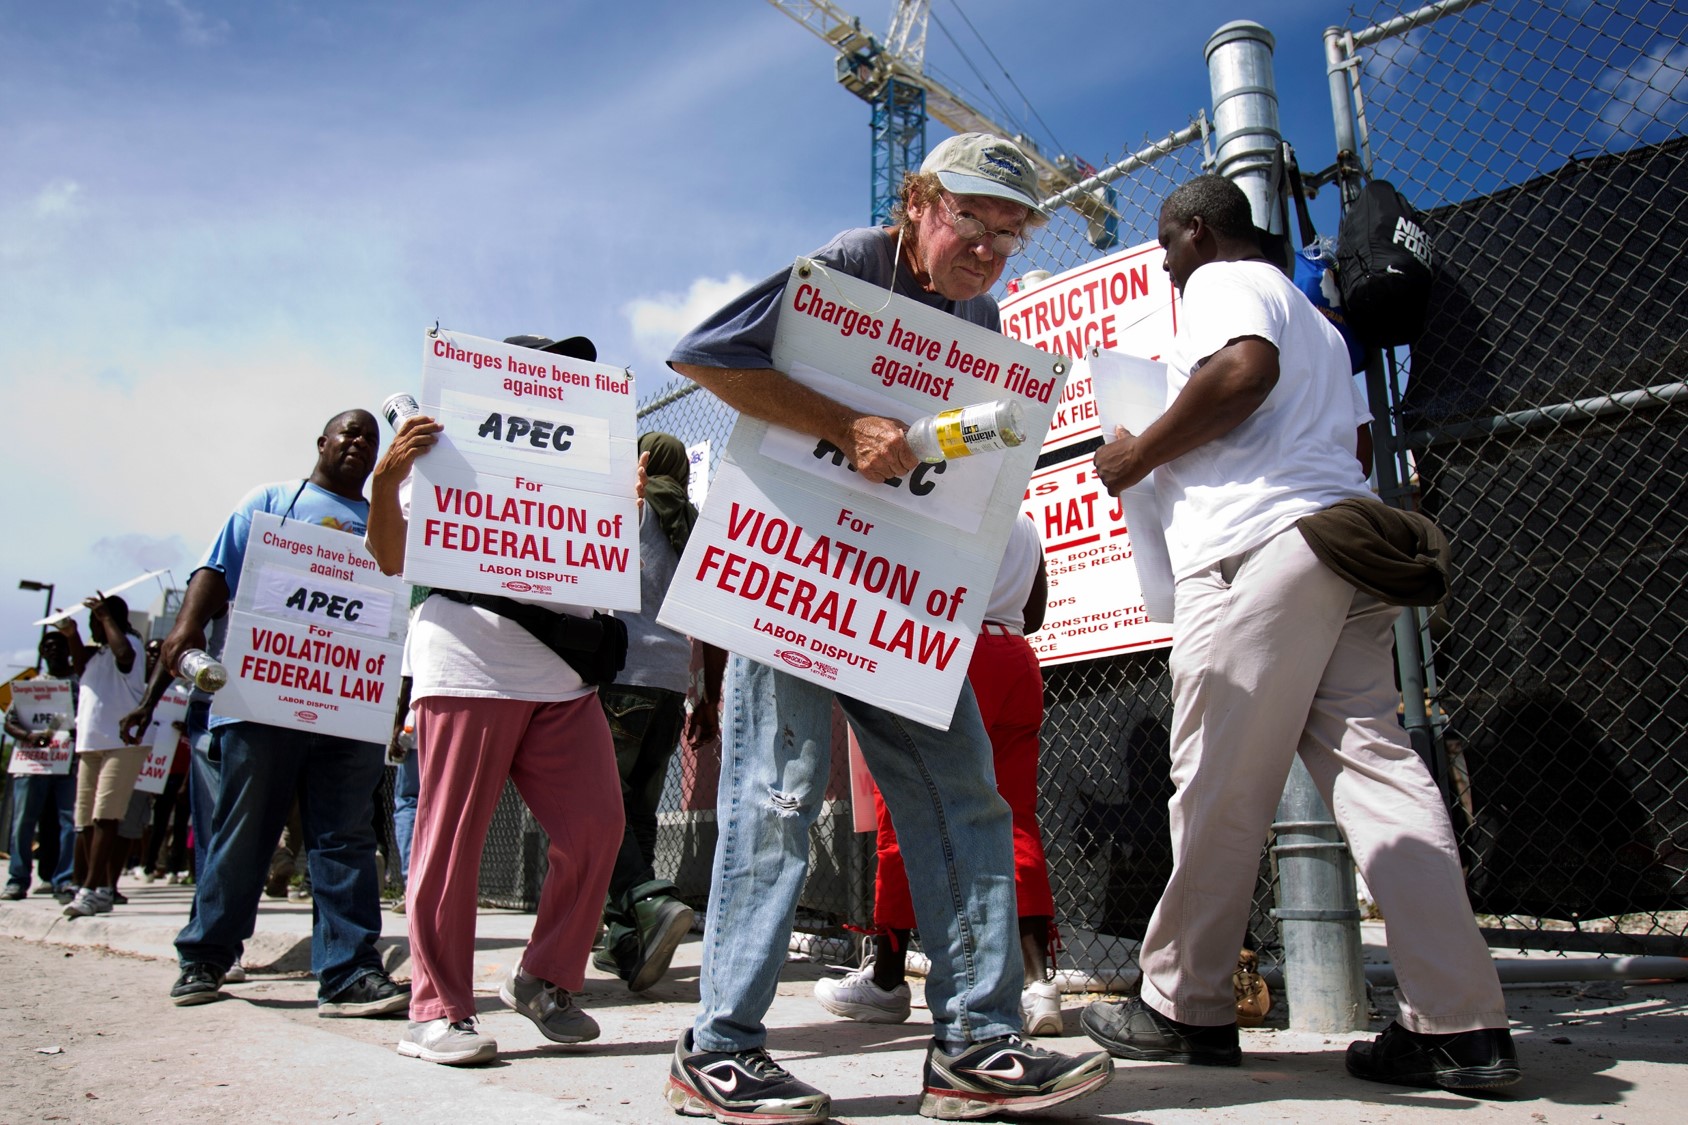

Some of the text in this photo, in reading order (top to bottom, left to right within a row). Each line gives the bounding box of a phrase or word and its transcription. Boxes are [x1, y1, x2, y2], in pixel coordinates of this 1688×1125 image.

[1003, 264, 1149, 340] STRUCTION
[793, 283, 1056, 403] Charges have been filed
[433, 339, 630, 395] Charges have been filed
[871, 355, 954, 402] against
[503, 378, 564, 401] against
[478, 412, 575, 451] APEC
[962, 429, 997, 444] vitamin
[515, 476, 543, 493] For
[434, 485, 623, 539] VIOLATION of
[836, 508, 874, 536] For
[1044, 491, 1099, 539] HAT
[263, 531, 376, 571] Charges have been
[424, 518, 630, 573] FEDERAL LAW
[726, 502, 967, 622] VIOLATION of
[1068, 543, 1122, 562] BOOTS,
[310, 561, 355, 582] against
[479, 563, 579, 585] LABOR DISPUTE
[286, 587, 363, 622] APEC
[695, 545, 961, 672] FEDERAL LAW
[308, 625, 333, 638] For
[753, 617, 878, 674] LABOR DISPUTE
[1047, 633, 1057, 641] A
[252, 627, 385, 676] VIOLATION of
[240, 655, 384, 703] FEDERAL LAW
[278, 695, 339, 711] LABOR DISPUTE
[16, 750, 69, 761] FEDERAL LAW
[140, 767, 166, 779] LAW
[155, 755, 167, 766] of
